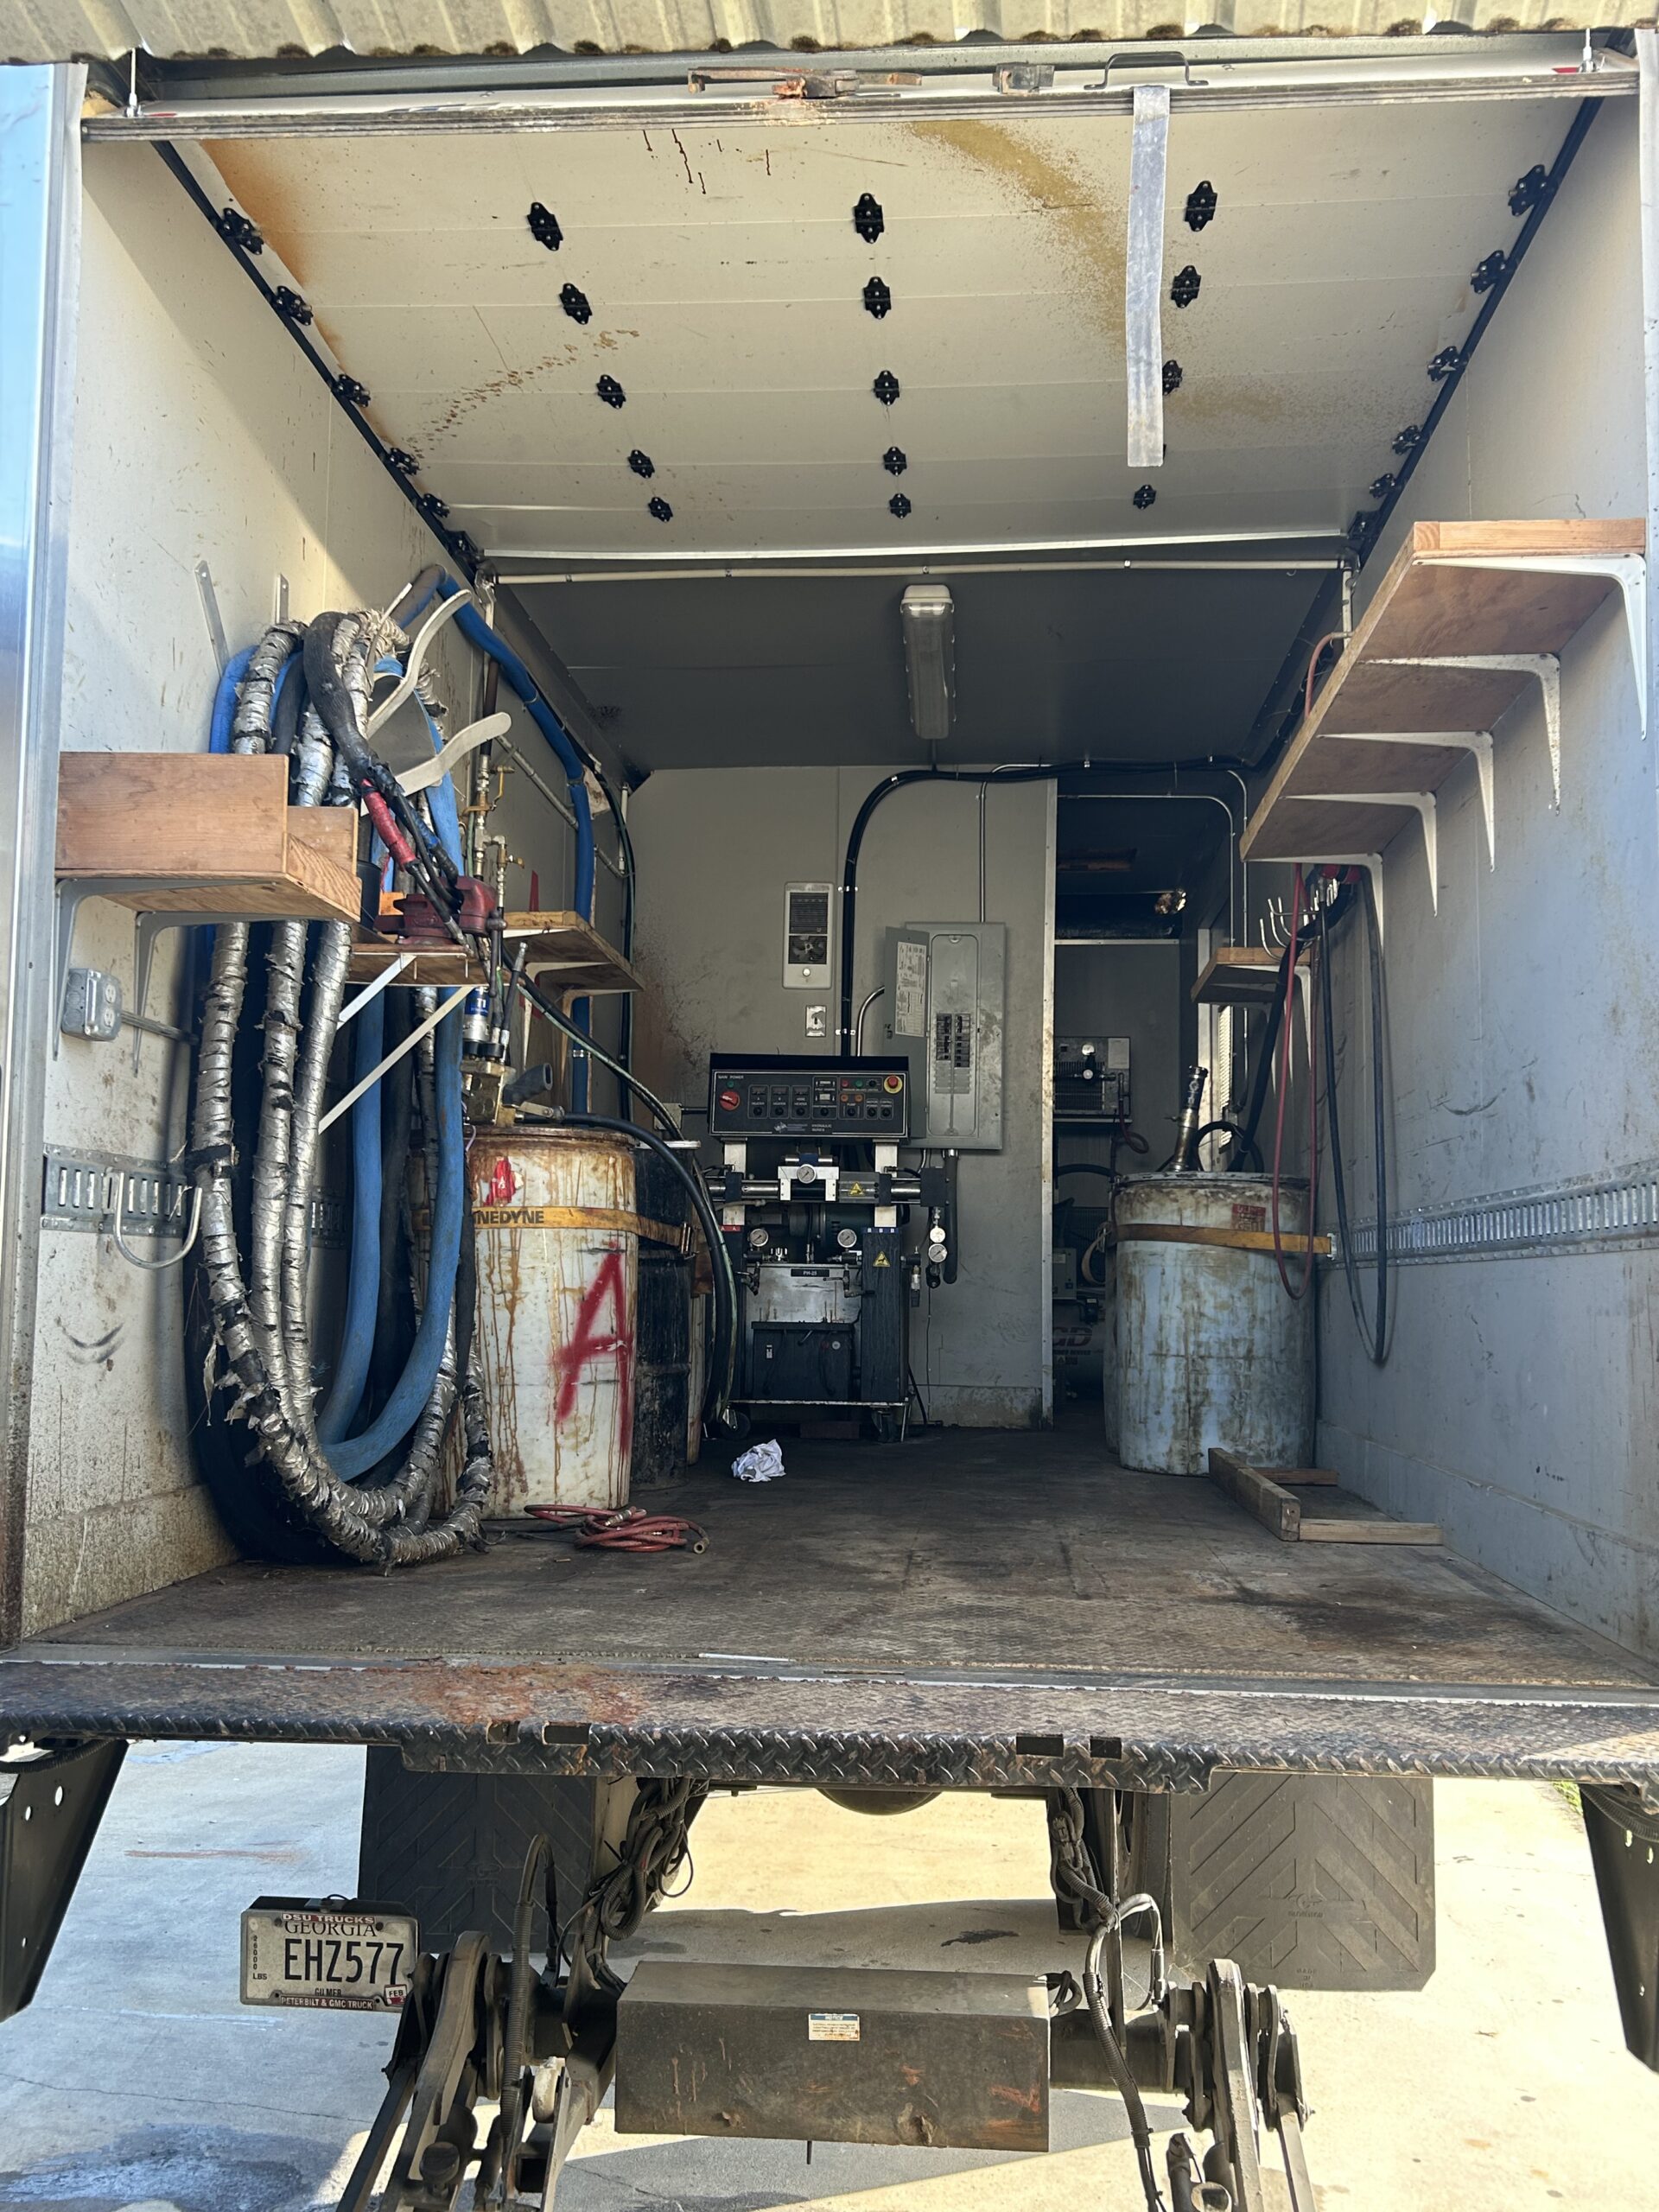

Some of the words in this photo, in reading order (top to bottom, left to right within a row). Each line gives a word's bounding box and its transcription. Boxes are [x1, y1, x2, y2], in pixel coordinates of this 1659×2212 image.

[551, 1240, 633, 1459] A
[283, 1913, 311, 1922] DSU
[317, 1915, 375, 1924] TRUCKS
[284, 1920, 378, 1936] GEORGIA
[284, 1938, 404, 1986] EHZ577
[252, 1972, 268, 1980] LBS
[389, 1989, 404, 1998] FEB
[281, 1997, 319, 2006] PETERBILT
[329, 1999, 346, 2008] GMC
[348, 2000, 373, 2010] TRUCK
